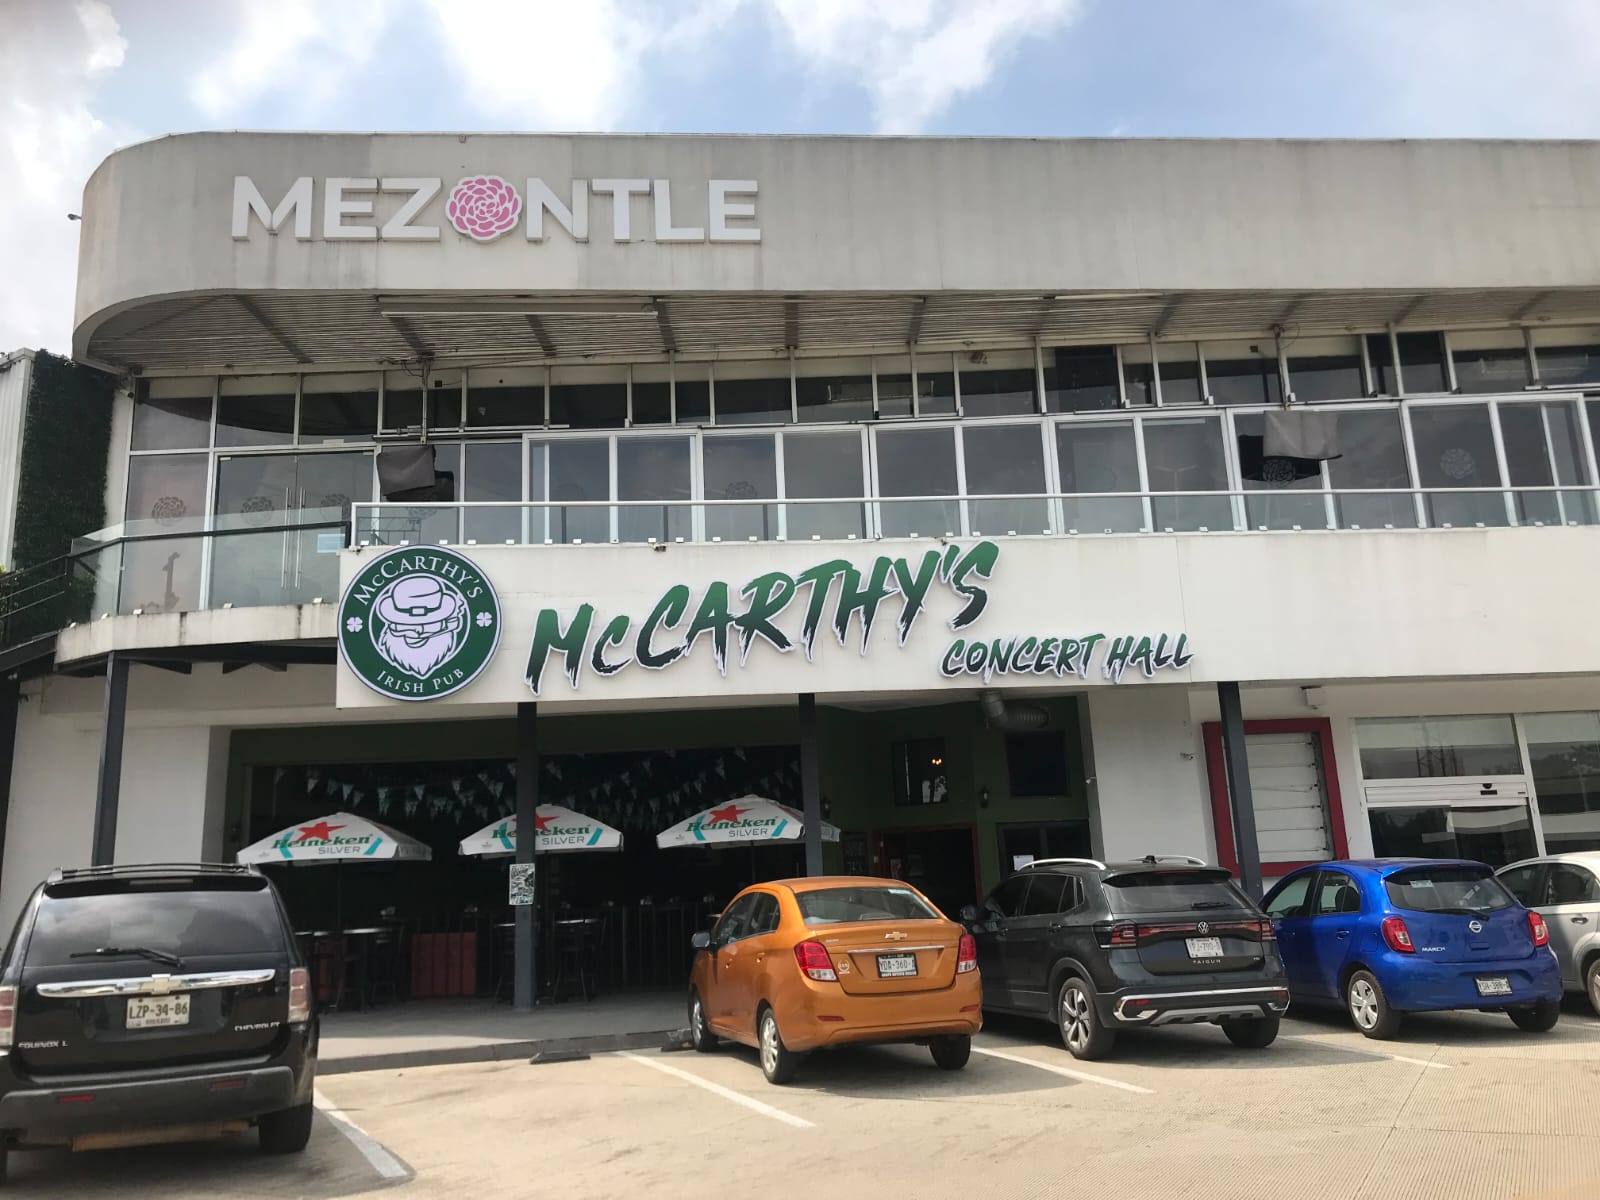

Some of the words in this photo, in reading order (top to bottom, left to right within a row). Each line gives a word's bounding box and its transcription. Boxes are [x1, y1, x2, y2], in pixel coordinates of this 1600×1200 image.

[941, 633, 1105, 684] CONCERT
[1103, 632, 1194, 684] HALL
[376, 670, 424, 693] IRISH
[432, 668, 464, 690] PUB
[491, 825, 589, 839] Heeken
[685, 817, 776, 832] Heineken
[728, 827, 768, 838] SILVER
[272, 834, 371, 850] Heineken
[541, 835, 585, 846] SILVER
[318, 845, 361, 855] SILVER
[129, 1002, 188, 1020] LZP-34-86
